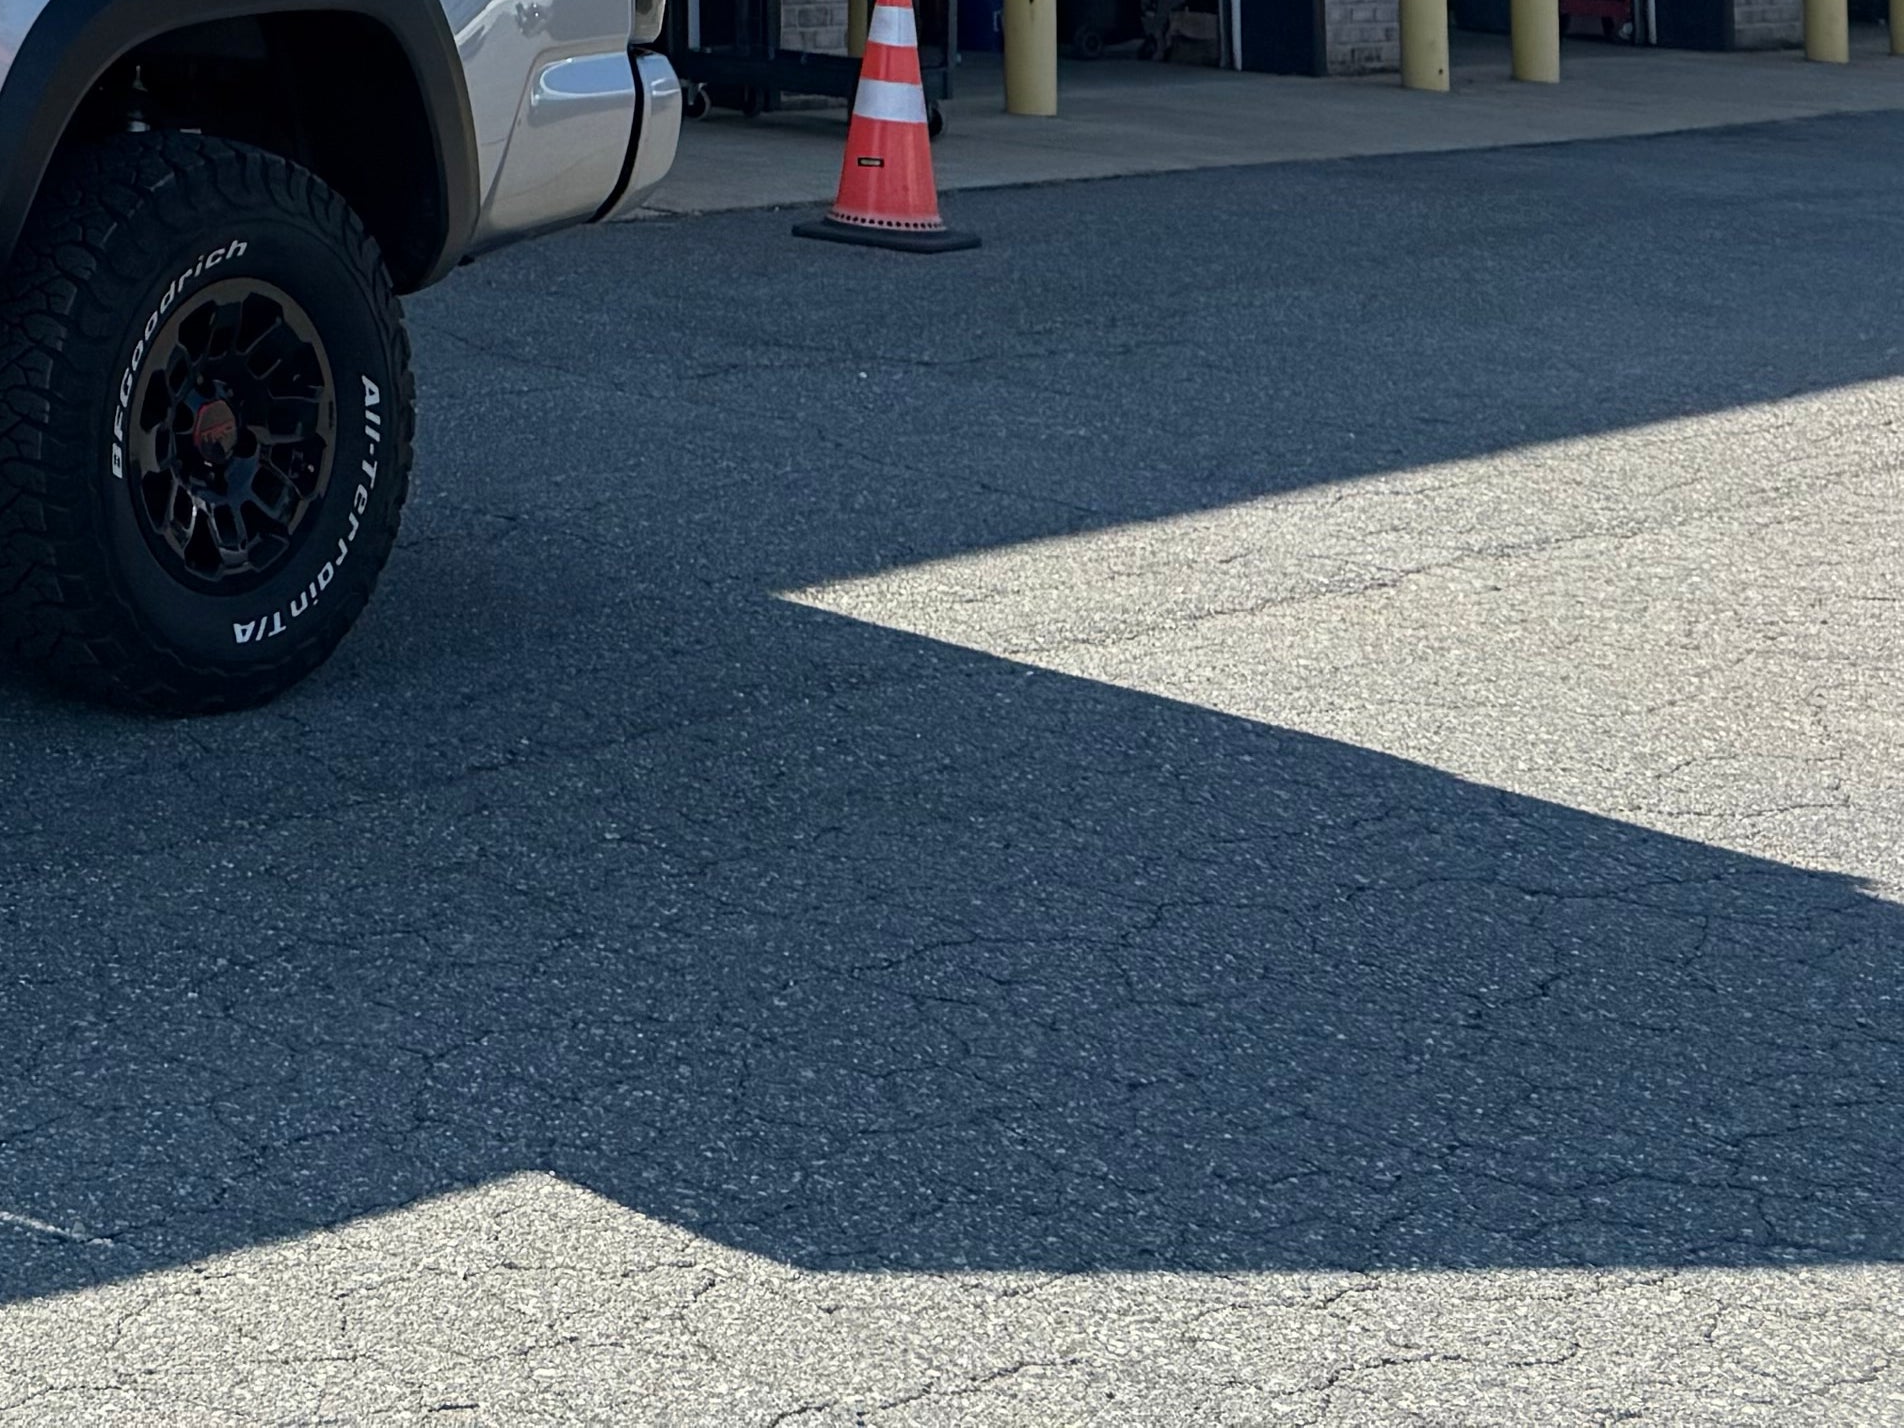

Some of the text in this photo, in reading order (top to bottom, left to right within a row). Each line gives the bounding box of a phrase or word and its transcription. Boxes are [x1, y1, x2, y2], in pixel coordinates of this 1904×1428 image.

[111, 239, 247, 479] BFGoodrich
[233, 374, 381, 644] All-Terrain T/A
